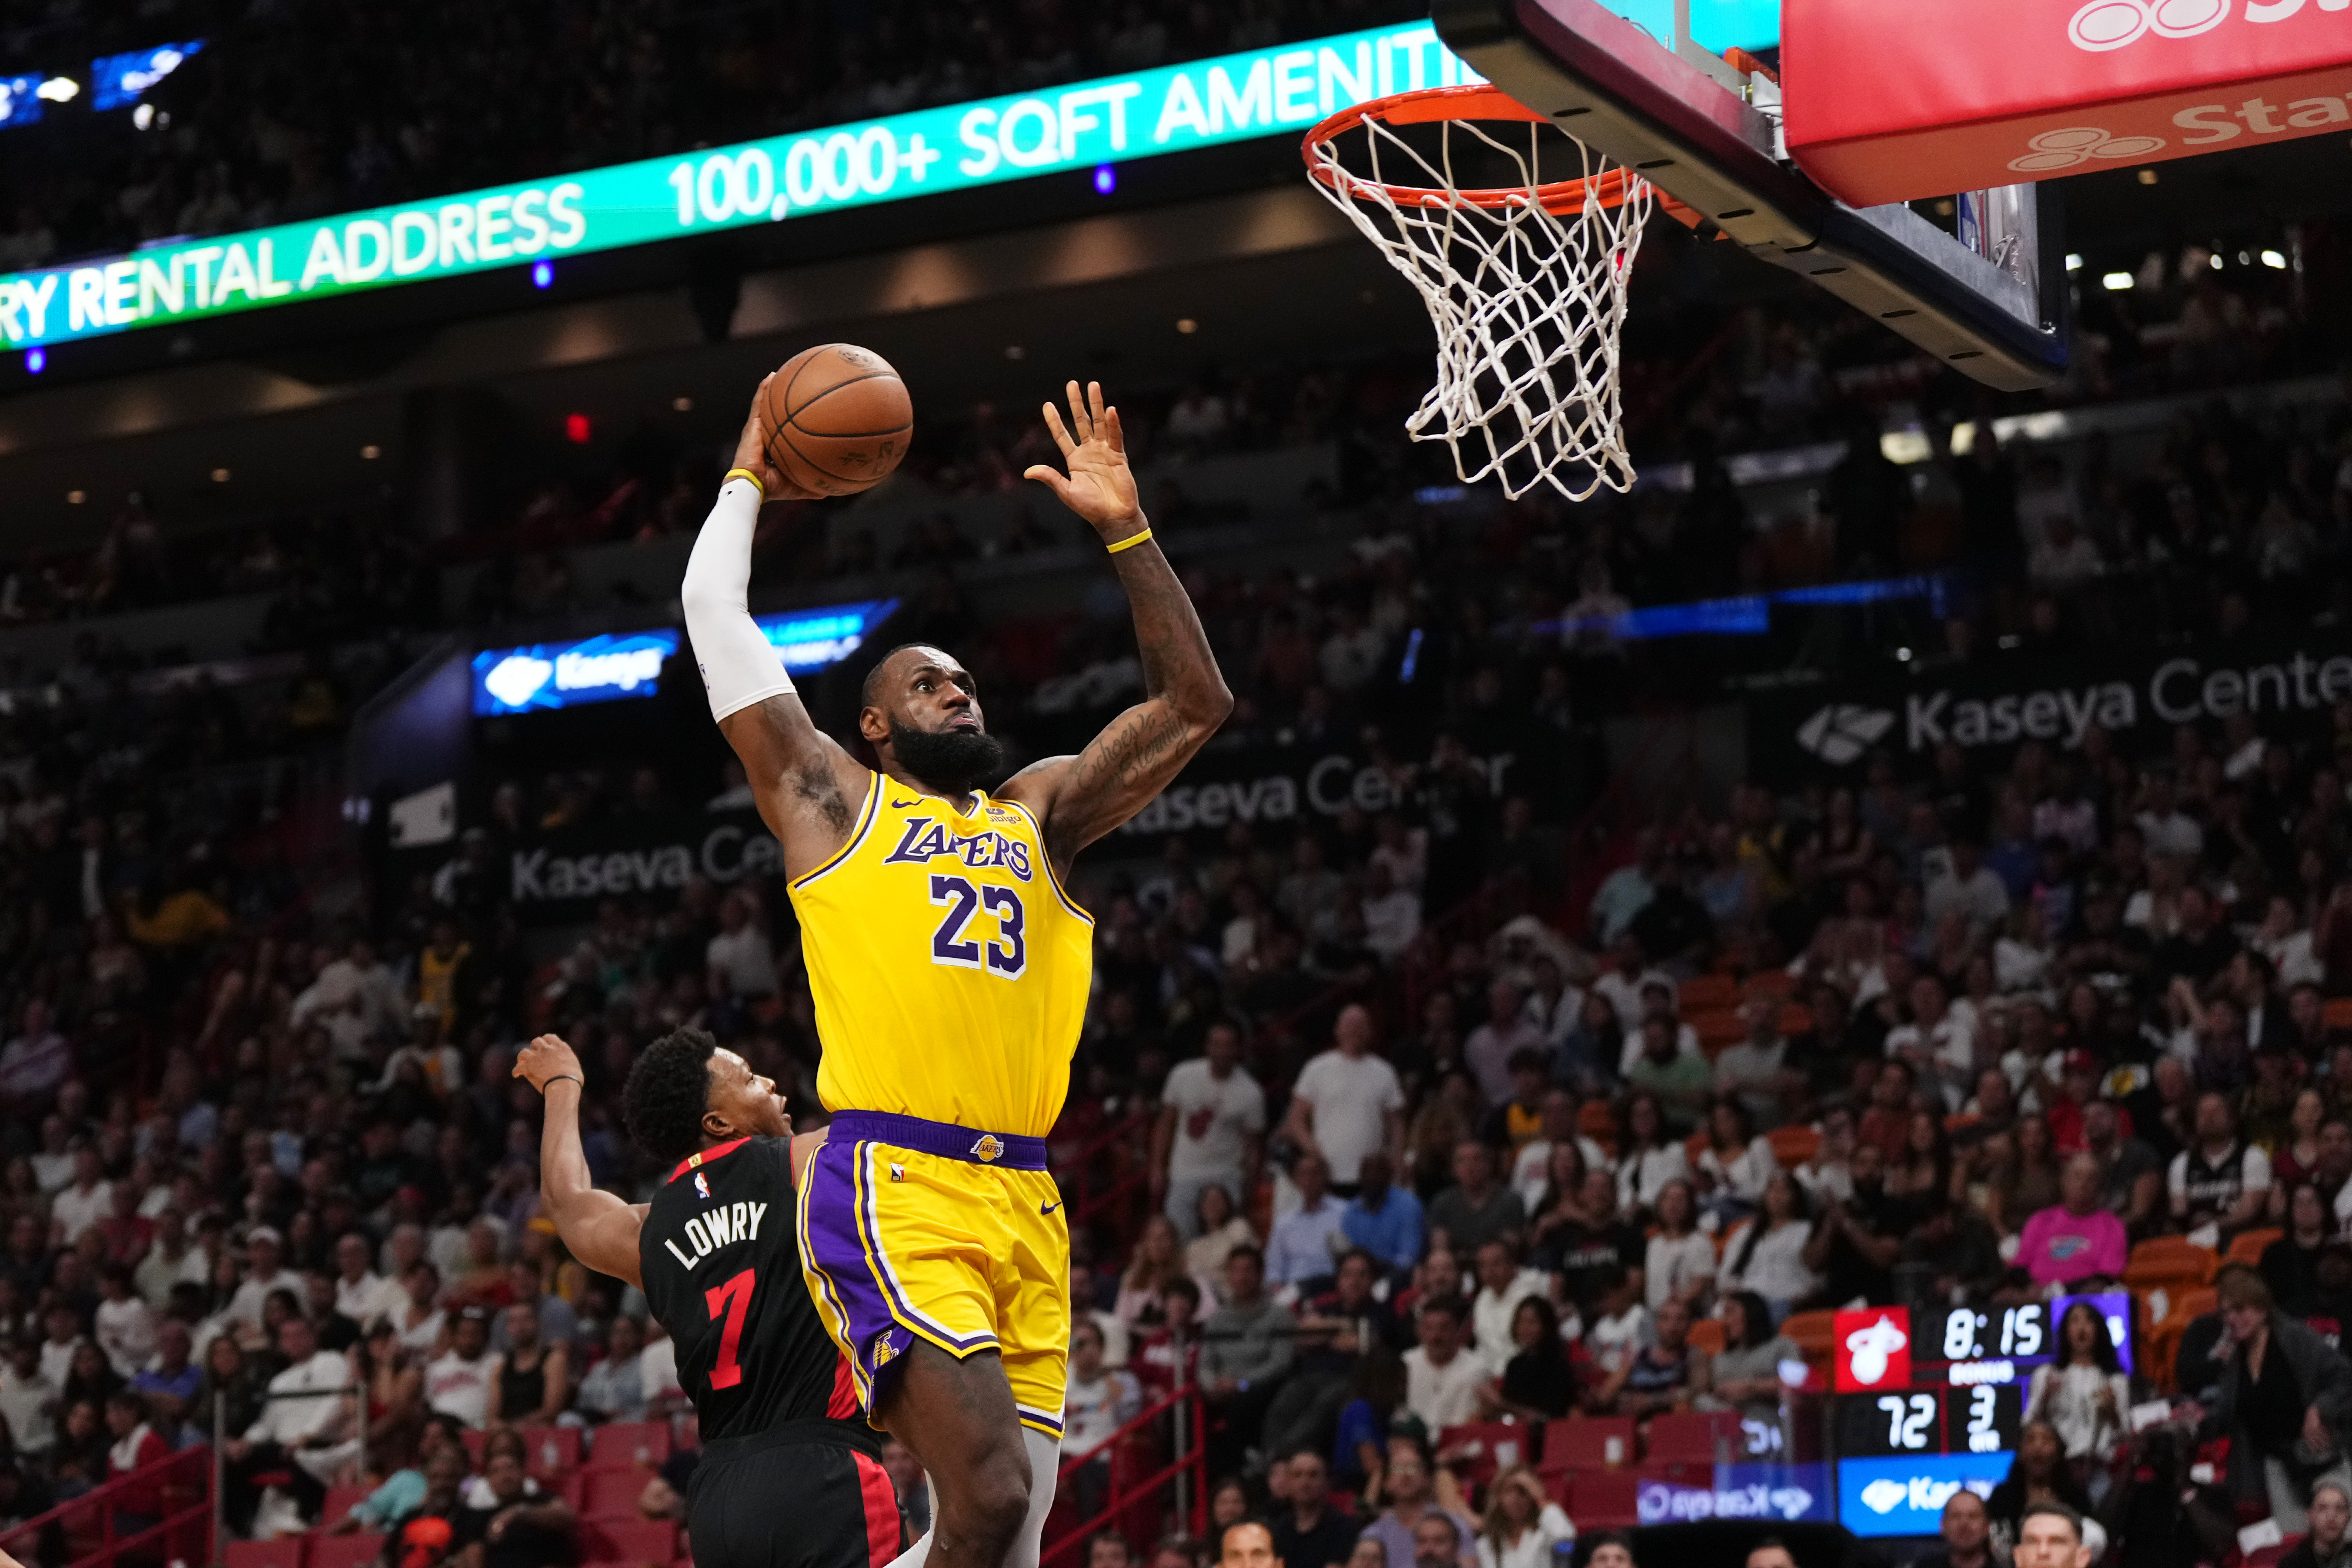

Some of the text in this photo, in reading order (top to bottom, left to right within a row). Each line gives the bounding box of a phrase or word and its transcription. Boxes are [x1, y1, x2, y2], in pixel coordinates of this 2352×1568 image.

[2172, 92, 2352, 145] Sta
[0, 275, 58, 340] RY
[69, 238, 292, 330] RENTAL
[299, 183, 586, 292] ADDRESS
[668, 127, 941, 226] 100,000+
[958, 82, 1142, 176] SQFT
[1905, 680, 2137, 753] Kaseya
[881, 815, 1033, 883] LAKERS
[928, 872, 1027, 981] 23
[664, 1201, 767, 1271] LOWRY
[705, 1268, 756, 1390] 7
[1943, 1304, 2043, 1360] 8:15
[1877, 1393, 1937, 1449] 72
[1966, 1384, 1996, 1432] 3
